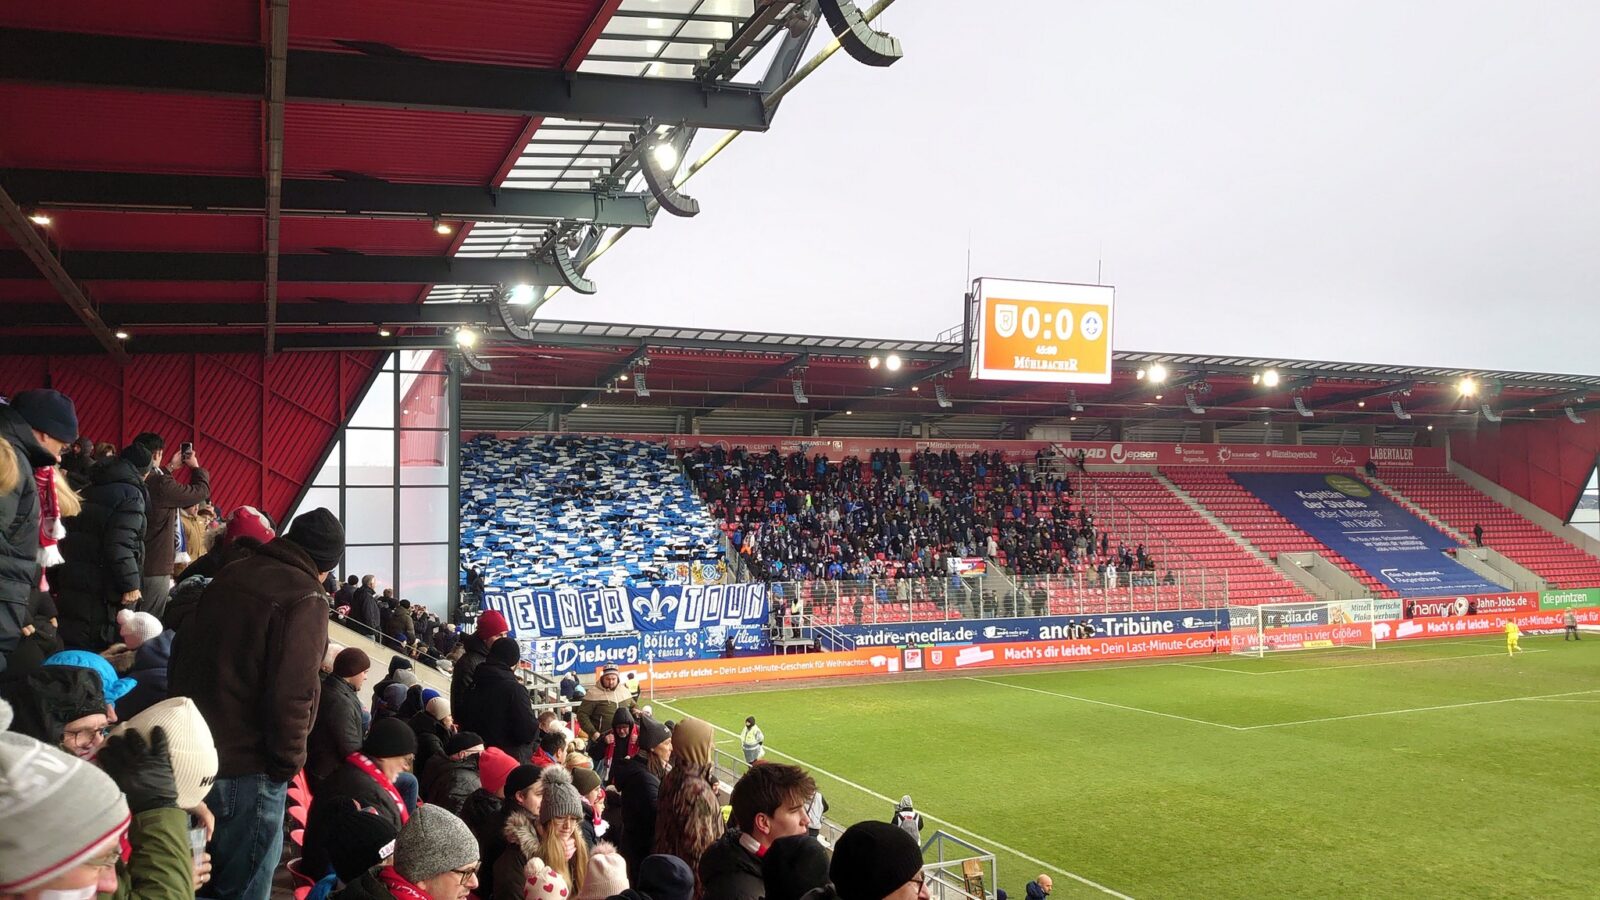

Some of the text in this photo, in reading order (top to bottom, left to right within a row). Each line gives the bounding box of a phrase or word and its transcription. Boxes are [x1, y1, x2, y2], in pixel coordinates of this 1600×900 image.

[1022, 306, 1074, 341] 0:0
[1369, 447, 1413, 460] LABERTALER
[1294, 490, 1346, 500] Kapitän
[1302, 500, 1326, 509] der
[682, 583, 765, 622] TOWN
[1351, 602, 1400, 611] Mittelyerische
[1411, 600, 1455, 616] harivri
[1476, 595, 1527, 609] Jahn-Jobs.de
[1229, 608, 1319, 626] andrmedia.de
[1354, 612, 1400, 621] Plakawerbung
[1427, 620, 1454, 633] Mach's
[1455, 619, 1466, 630] dir
[1467, 617, 1489, 630] leicht
[1588, 611, 1598, 621] für
[644, 631, 698, 648] Böller 98
[856, 626, 974, 645] andre-media.de
[1005, 647, 1042, 660] Mach's
[1044, 645, 1059, 657] dir
[1061, 643, 1092, 657] leicht
[1101, 643, 1125, 654] Dein
[1232, 634, 1246, 645] für
[1247, 631, 1303, 645] Wehnachten
[1314, 630, 1330, 640] vier
[1332, 627, 1362, 639] Größen
[556, 641, 638, 671] Dieburg
[651, 670, 678, 680] Mach's
[679, 669, 690, 678] dir
[691, 667, 713, 677] leicht
[720, 666, 736, 675] Dein
[738, 660, 813, 674] Last-Minute-Geschenk
[815, 659, 825, 668] für
[826, 658, 869, 668] Weihnachten
